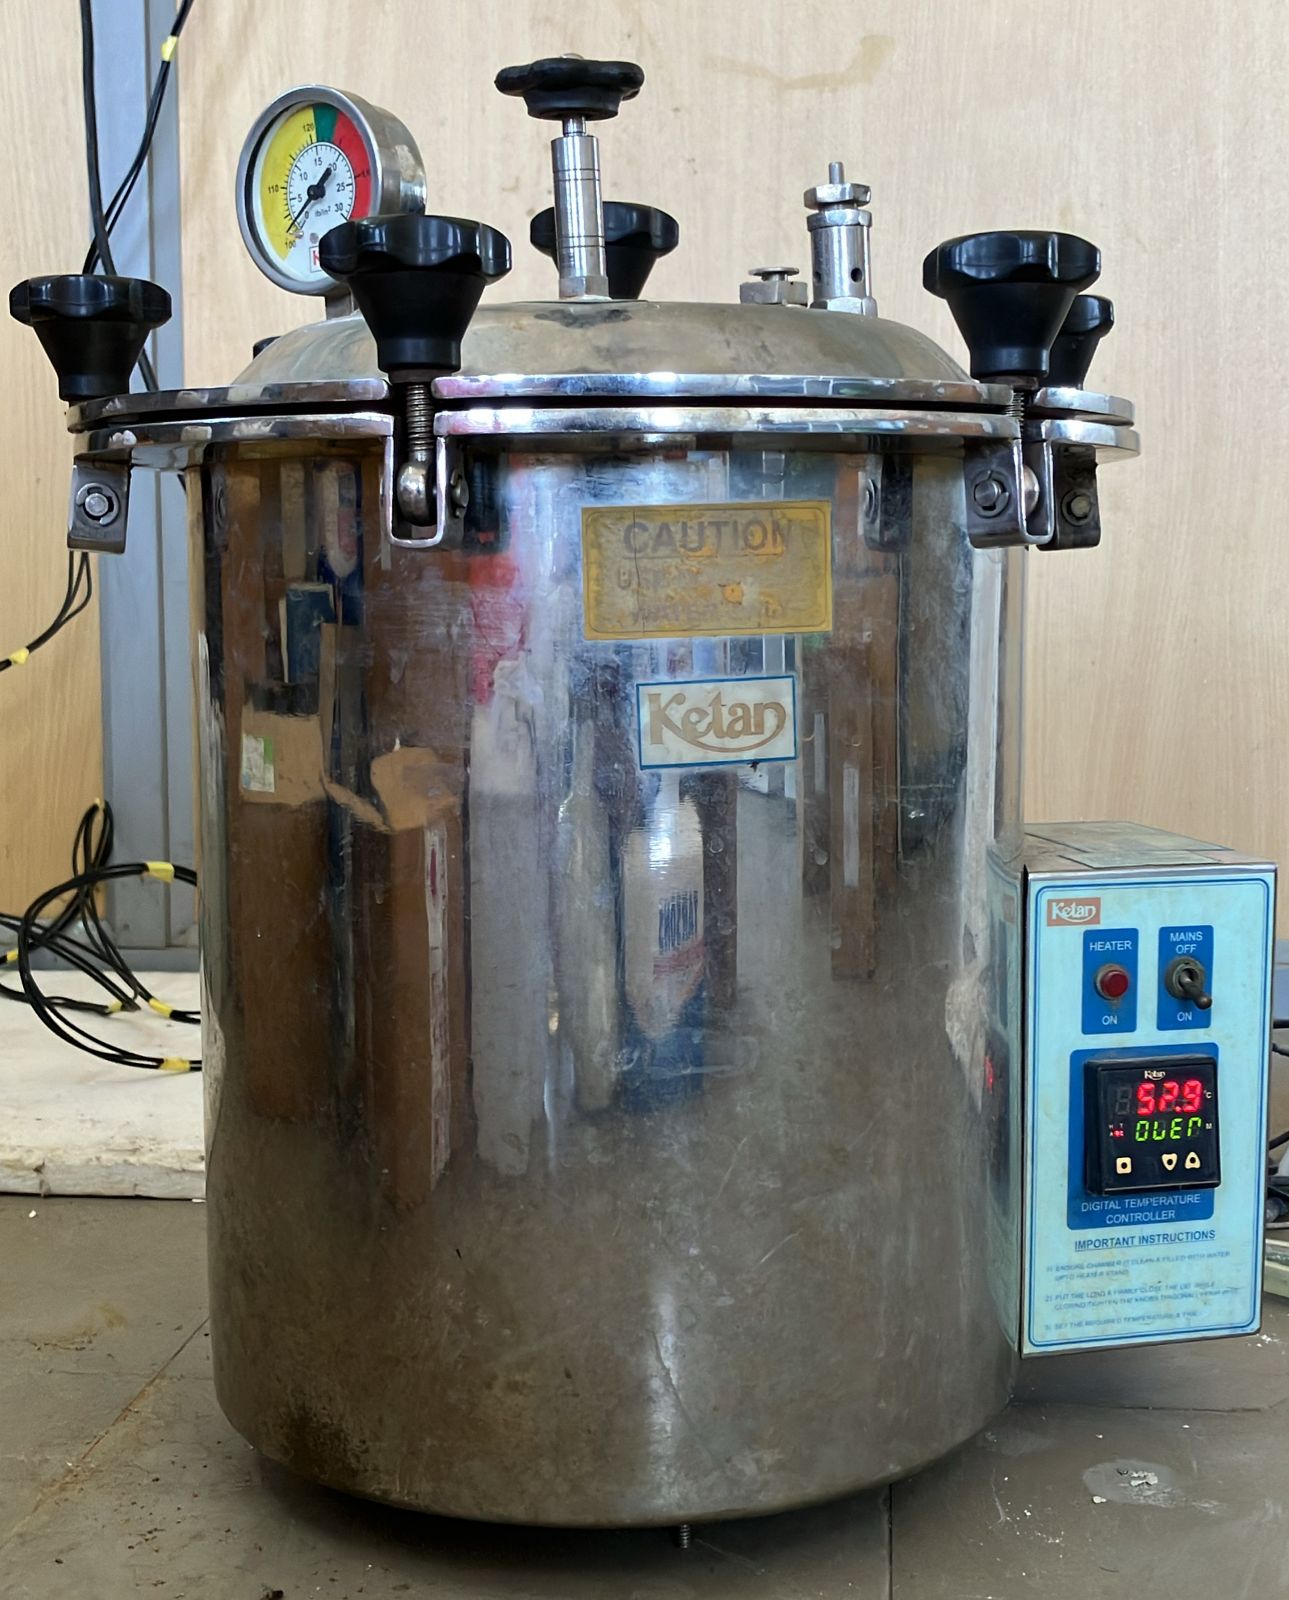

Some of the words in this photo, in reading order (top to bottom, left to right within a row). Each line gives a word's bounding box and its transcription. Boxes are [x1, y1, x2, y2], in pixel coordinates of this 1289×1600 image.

[302, 123, 315, 132] 120
[314, 157, 323, 166] 15
[299, 171, 308, 181] 10
[267, 185, 279, 194] 110
[336, 182, 346, 192] 25
[297, 194, 303, 203] 5
[334, 202, 344, 213] 30
[284, 239, 297, 249] 100
[623, 519, 791, 554] CAUTION
[647, 689, 788, 754] Ketan
[1051, 901, 1097, 923] Ketan
[1169, 931, 1203, 942] MAINS
[1089, 940, 1133, 952] HEATER
[1175, 943, 1197, 955] OFF
[1101, 1015, 1118, 1026] ON
[1176, 1011, 1193, 1022] ON
[1081, 1199, 1121, 1213] DIGITAL
[1124, 1193, 1201, 1209] TEMPERATURE
[1106, 1210, 1176, 1226] CONTROLLER
[1074, 1235, 1136, 1250] IMPORTANT
[1138, 1230, 1216, 1245] INSTRUCTIONS
